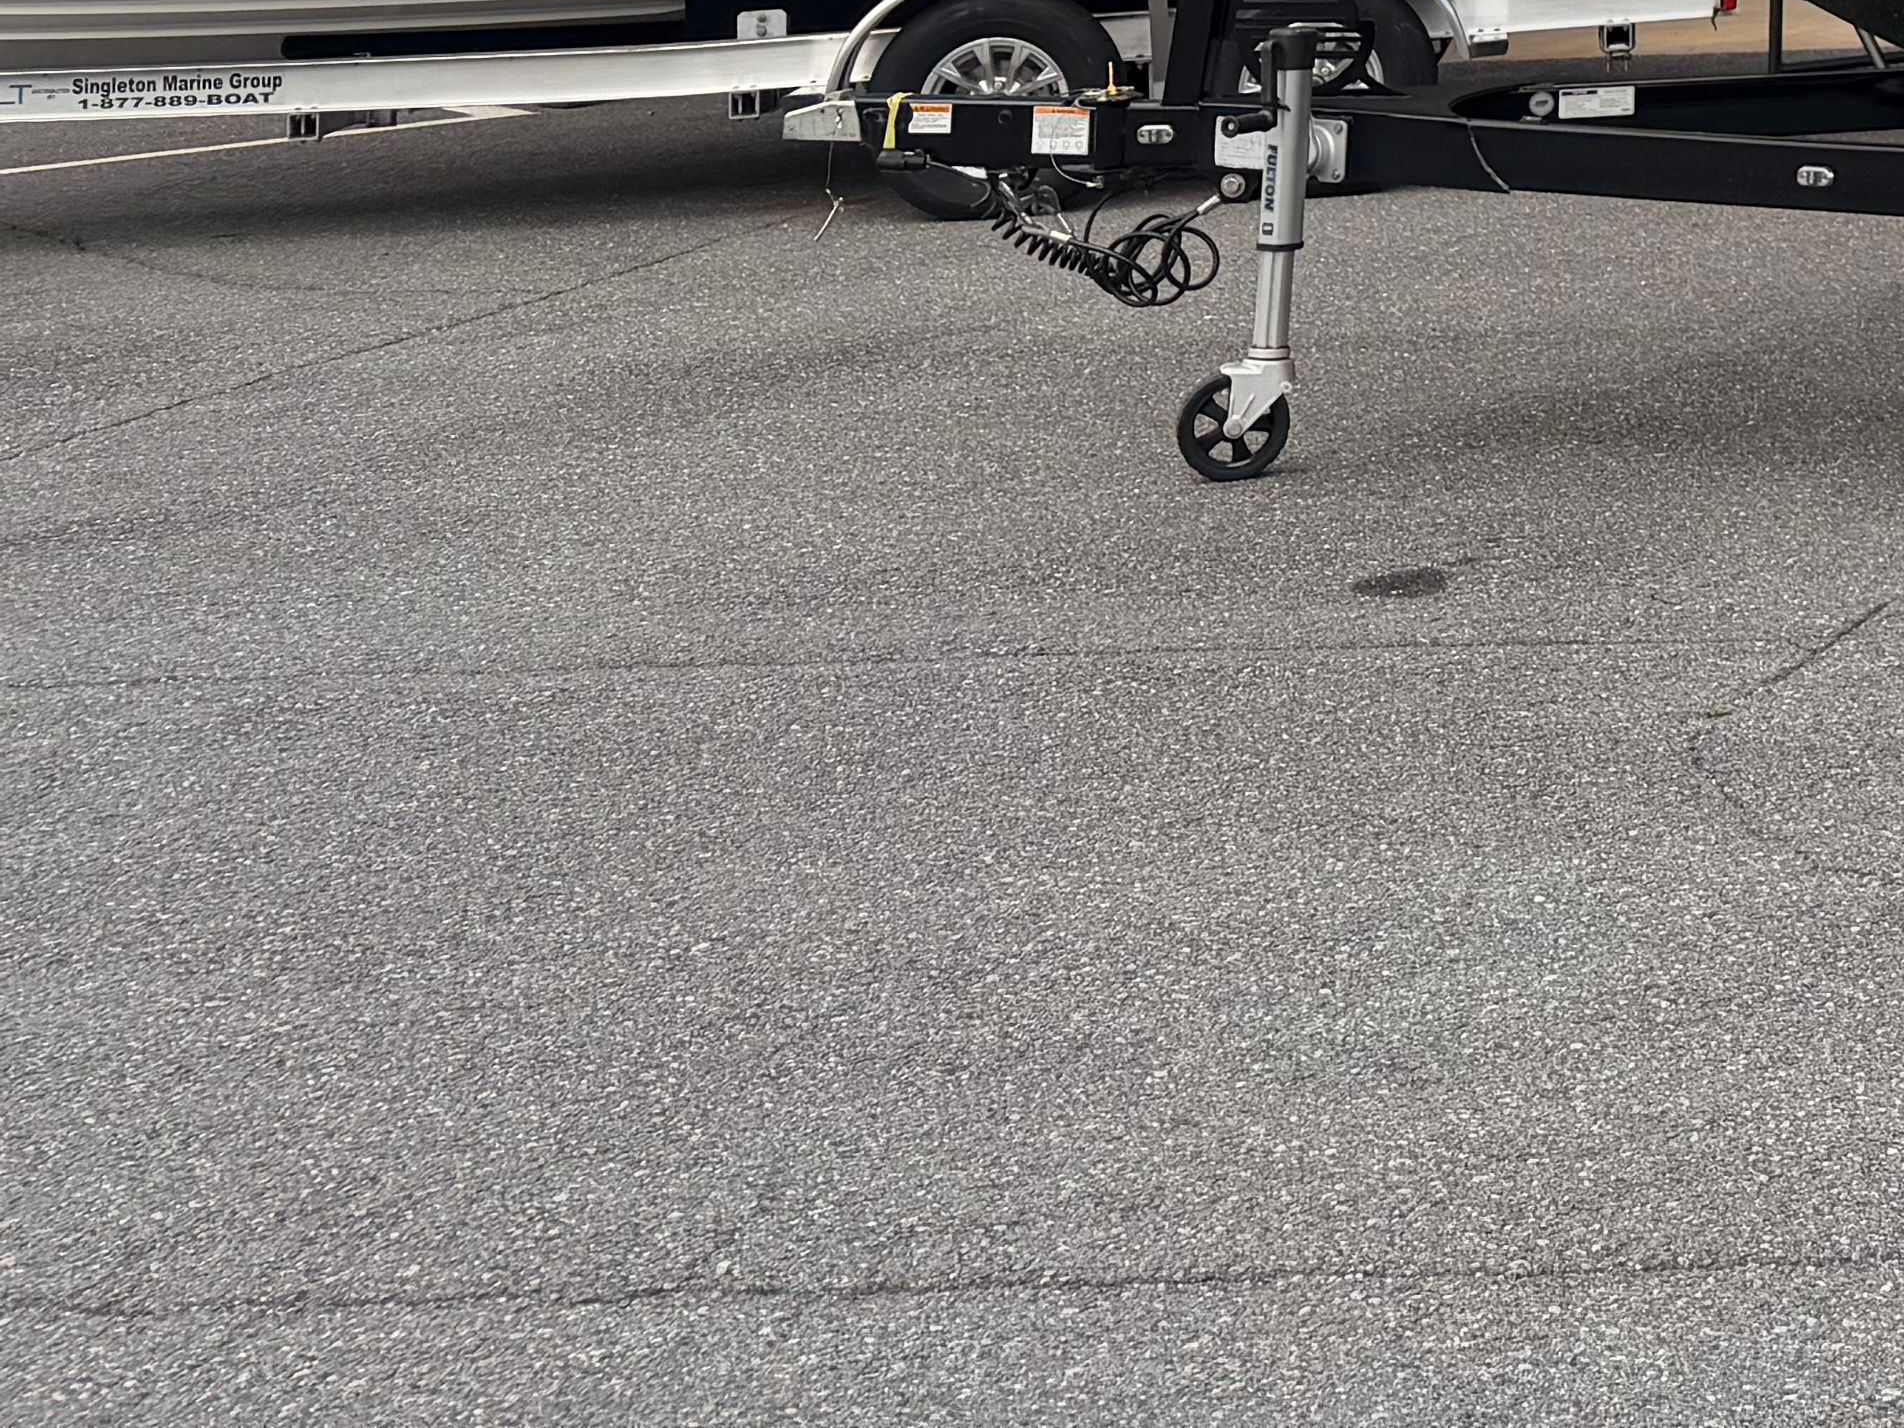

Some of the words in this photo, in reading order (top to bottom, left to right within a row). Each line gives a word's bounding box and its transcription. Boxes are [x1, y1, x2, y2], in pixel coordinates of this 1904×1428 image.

[72, 76, 157, 96] Singleton
[163, 74, 223, 92] Marine
[229, 72, 283, 92] Group
[78, 92, 275, 110] 1-877-889-BOAT
[1263, 143, 1279, 212] FULTON
